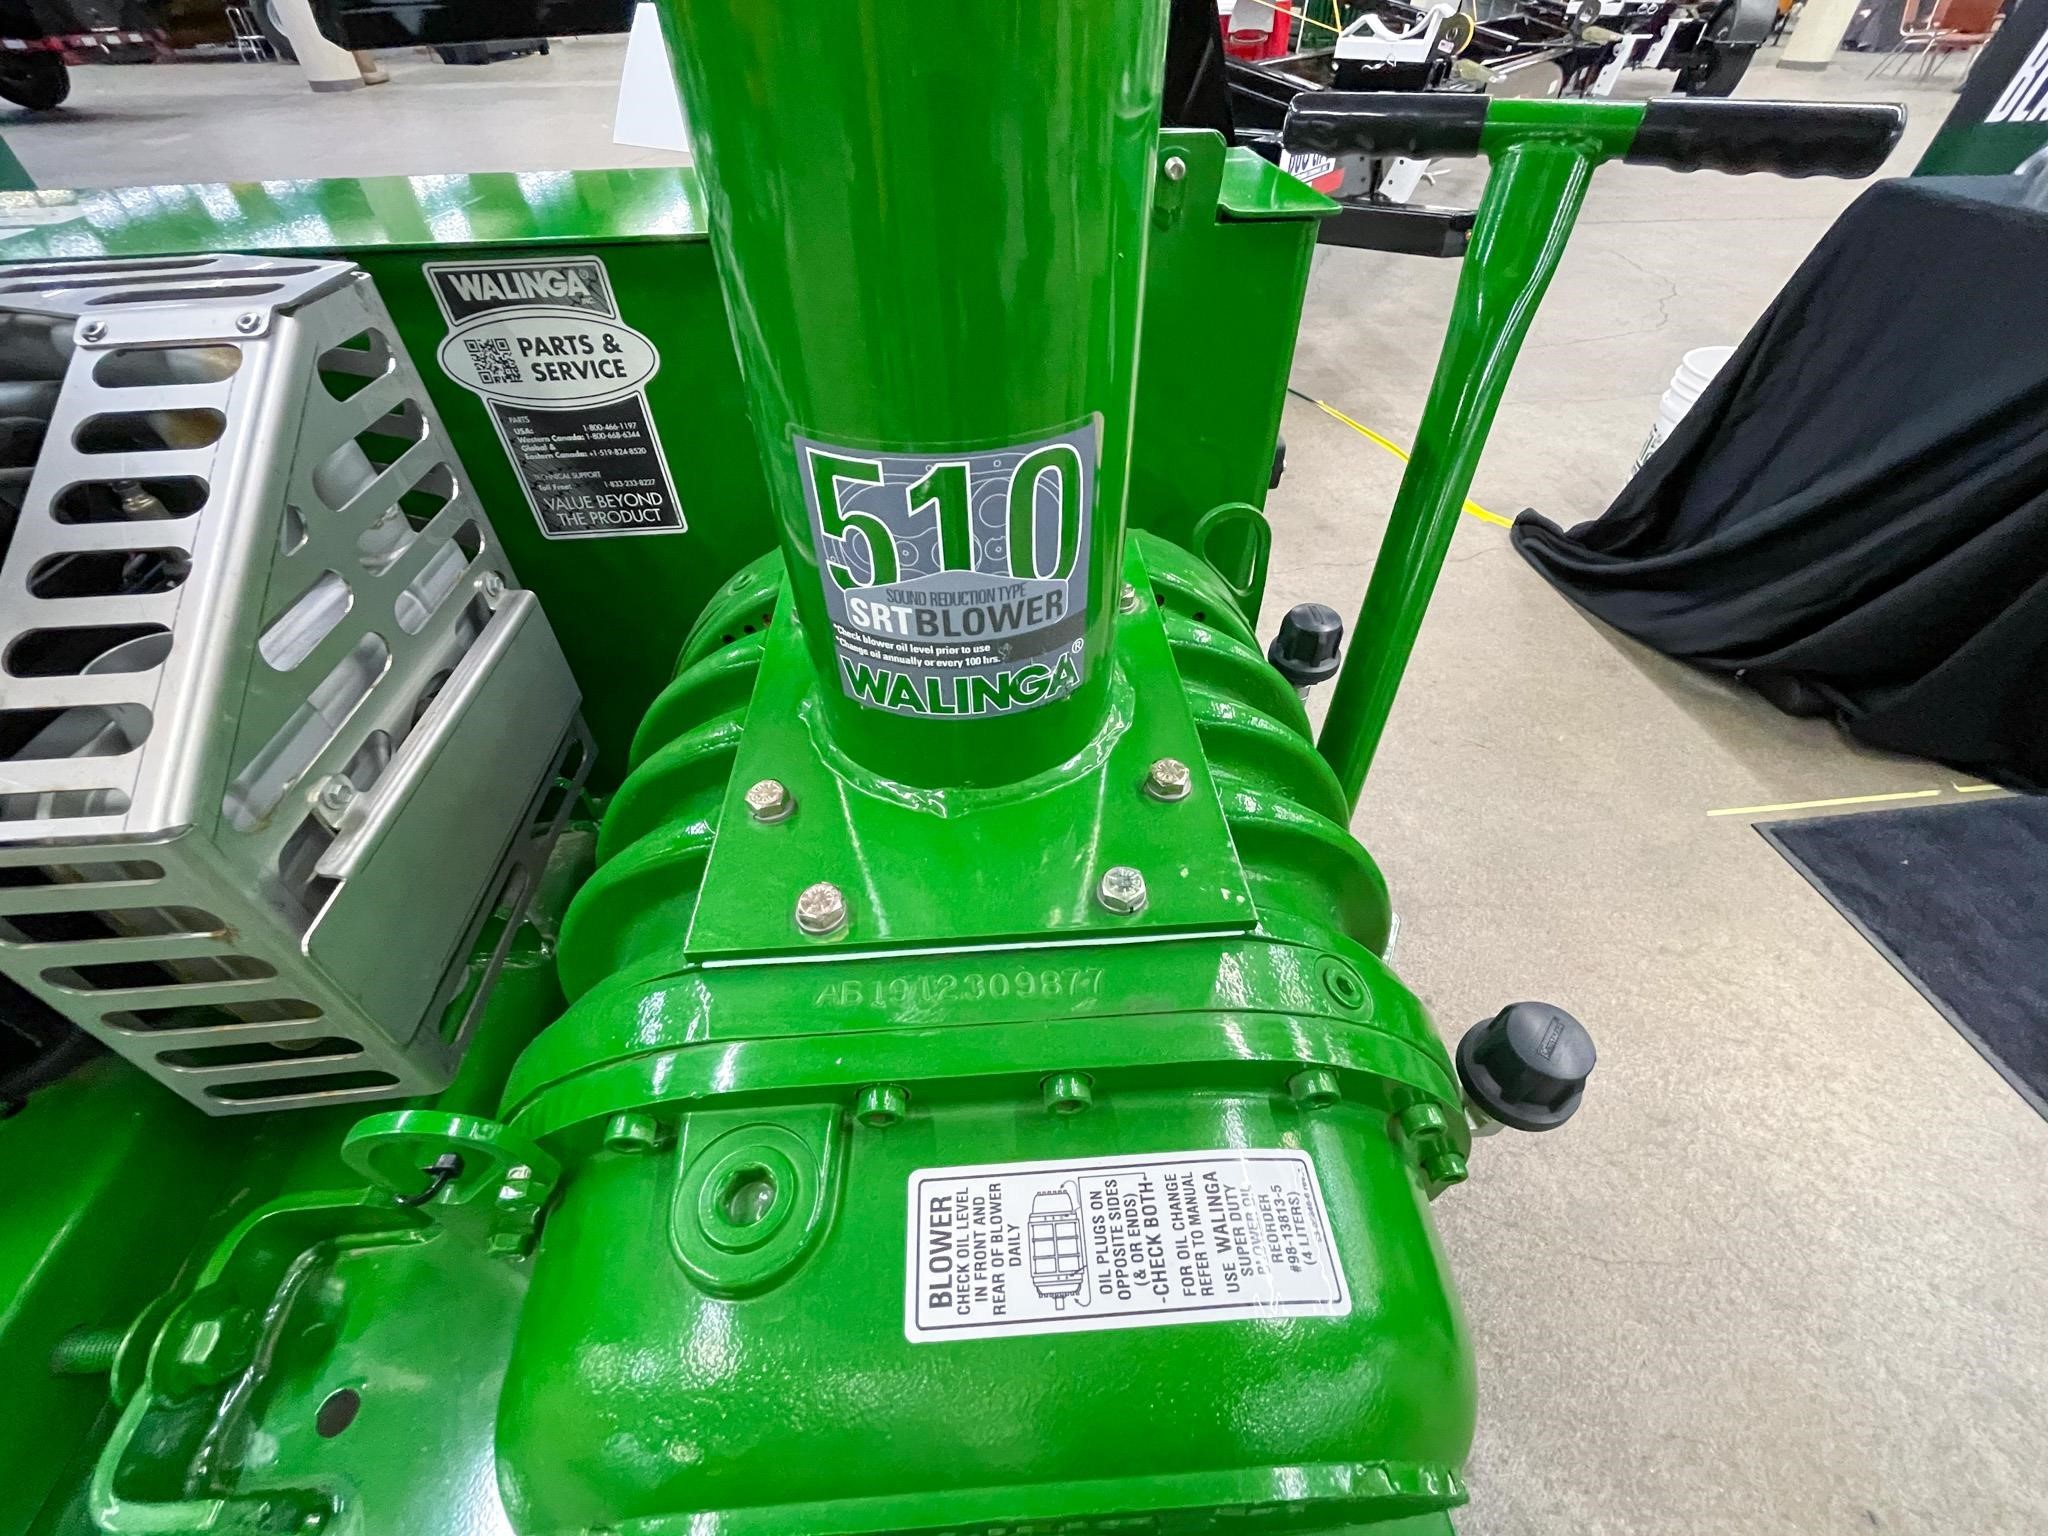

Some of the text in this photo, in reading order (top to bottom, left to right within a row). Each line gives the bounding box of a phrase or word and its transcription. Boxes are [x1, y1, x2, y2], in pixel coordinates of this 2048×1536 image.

[517, 333, 623, 357] PARTS &
[531, 359, 627, 382] SERVICE
[517, 435, 550, 443] Western
[520, 444, 547, 452] Global
[524, 452, 554, 460] Eastern
[544, 492, 663, 510] VALUE BEYOND
[571, 471, 601, 479] SUPPORT
[557, 508, 661, 526] THE PRODUCT
[806, 443, 1083, 590] 510
[886, 583, 1027, 607] SOUND REDUCTION TYPE
[862, 635, 894, 649] blower
[896, 643, 908, 652] oil
[909, 644, 934, 654] level
[936, 645, 960, 656] prior
[961, 646, 971, 654] to
[973, 645, 991, 653] use
[870, 648, 881, 659] oil
[883, 653, 922, 668] annually
[936, 659, 963, 669] every
[965, 656, 981, 666] 100
[973, 1197, 988, 1301] IN FRONT AND
[989, 1183, 1006, 1315] REAR OF BLOWER
[1007, 1223, 1022, 1266] DAILY
[1090, 1191, 1113, 1294] OIL PLUGS ON
[1105, 1179, 1131, 1300] OPPOSITE SIDES
[1123, 1193, 1151, 1286] (& OR ENDS)
[1165, 1173, 1196, 1297] FOR OIL CHANGE
[1181, 1171, 1214, 1296] REFER TO MANUAL
[1203, 1171, 1240, 1293] USE WALINGA
[1223, 1184, 1254, 1277] SUPER DUTY
[1245, 1212, 1271, 1275] BOWER
[1258, 1194, 1284, 1263] REORDER
[1271, 1184, 1302, 1273] #98-13813-5
[1287, 1191, 1311, 1247] LITERS)
[929, 1196, 952, 1309] BLOWER
[956, 1187, 970, 1315] CHECK OIL LEVEL
[1302, 1251, 1317, 1265] (4
